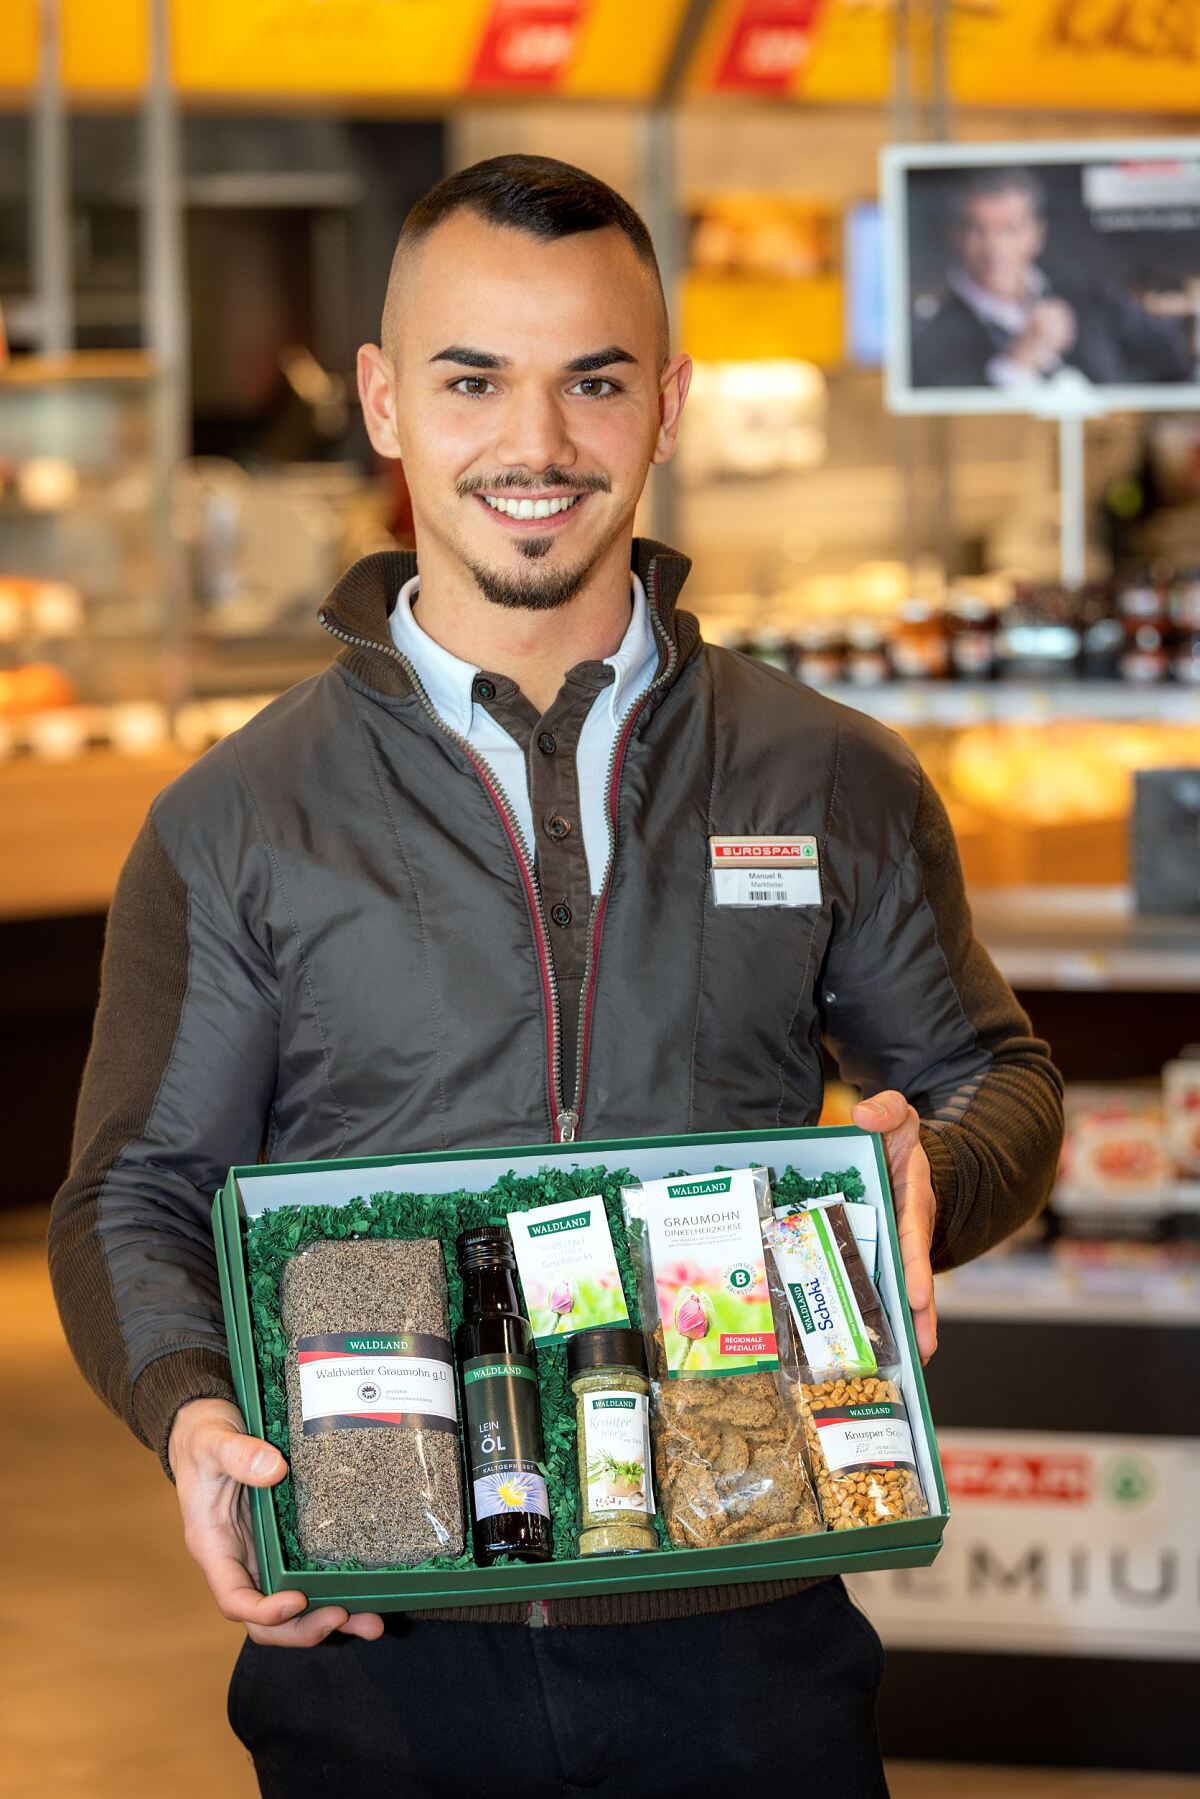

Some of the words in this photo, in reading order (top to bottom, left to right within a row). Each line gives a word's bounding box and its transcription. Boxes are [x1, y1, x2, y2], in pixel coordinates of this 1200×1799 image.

[723, 847, 800, 856] EUROSPAR
[749, 872, 776, 880] Manuel
[672, 1182, 727, 1196] WALDLAND
[664, 1210, 740, 1228] GRAUMOHN
[532, 1217, 587, 1235] WALDLAND
[664, 1222, 742, 1238] DINKELHERZKEKSE
[794, 1286, 814, 1331] WALDLAND
[806, 1277, 834, 1331] Schoki
[350, 1341, 409, 1350] WALDLAND
[725, 1343, 766, 1351] SPEZIALITÄT
[316, 1366, 375, 1380] Waldviertler
[378, 1365, 430, 1378] Graumohn
[473, 1366, 522, 1379] WALDLAND
[595, 1400, 634, 1408] WALDLAND
[850, 1407, 891, 1417] WALDLAND
[479, 1420, 500, 1433] LEIN
[845, 1430, 884, 1441] Knusper
[481, 1433, 506, 1454] ÖL
[949, 1464, 1089, 1498] PAR
